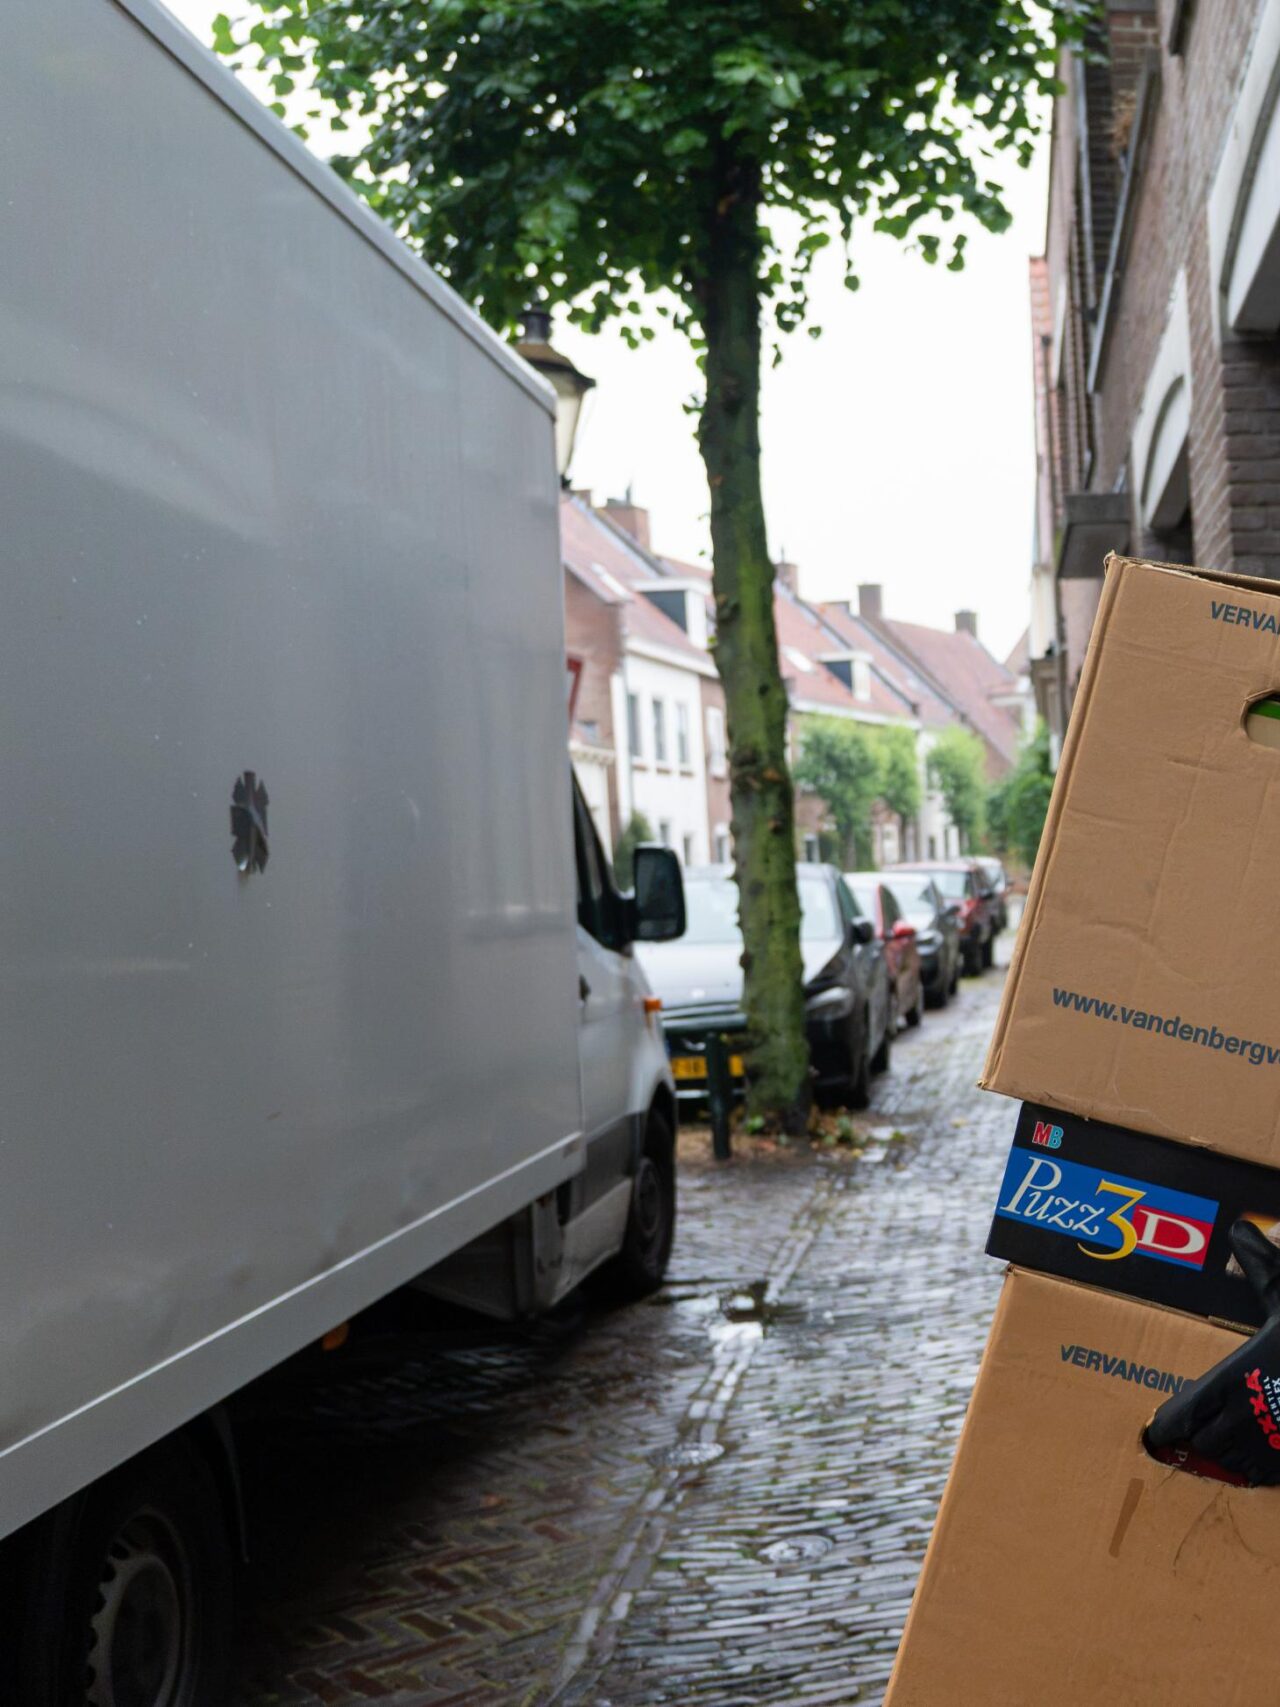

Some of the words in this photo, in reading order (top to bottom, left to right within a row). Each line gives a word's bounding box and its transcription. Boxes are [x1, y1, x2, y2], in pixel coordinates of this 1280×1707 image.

[1032, 1121, 1064, 1149] MB
[1000, 1156, 1106, 1236] Puzz
[1060, 1344, 1196, 1394] VERVANGIN
